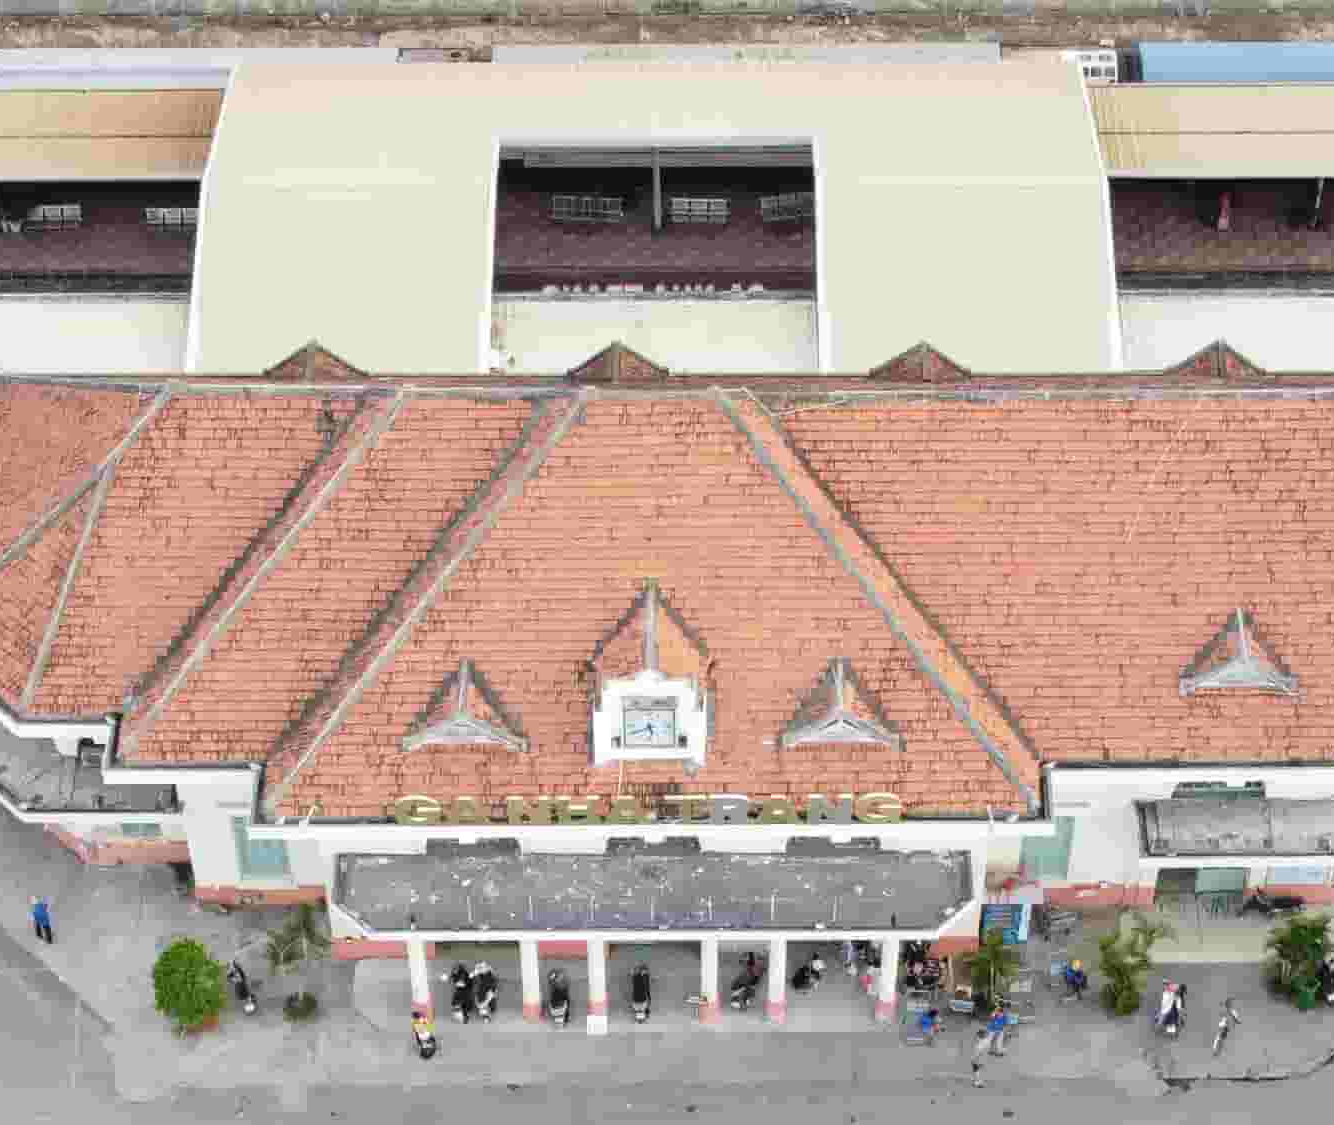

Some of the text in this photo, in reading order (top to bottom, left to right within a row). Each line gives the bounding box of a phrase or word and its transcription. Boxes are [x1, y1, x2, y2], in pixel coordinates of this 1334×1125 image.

[394, 793, 903, 825] GA NHA TRANG
